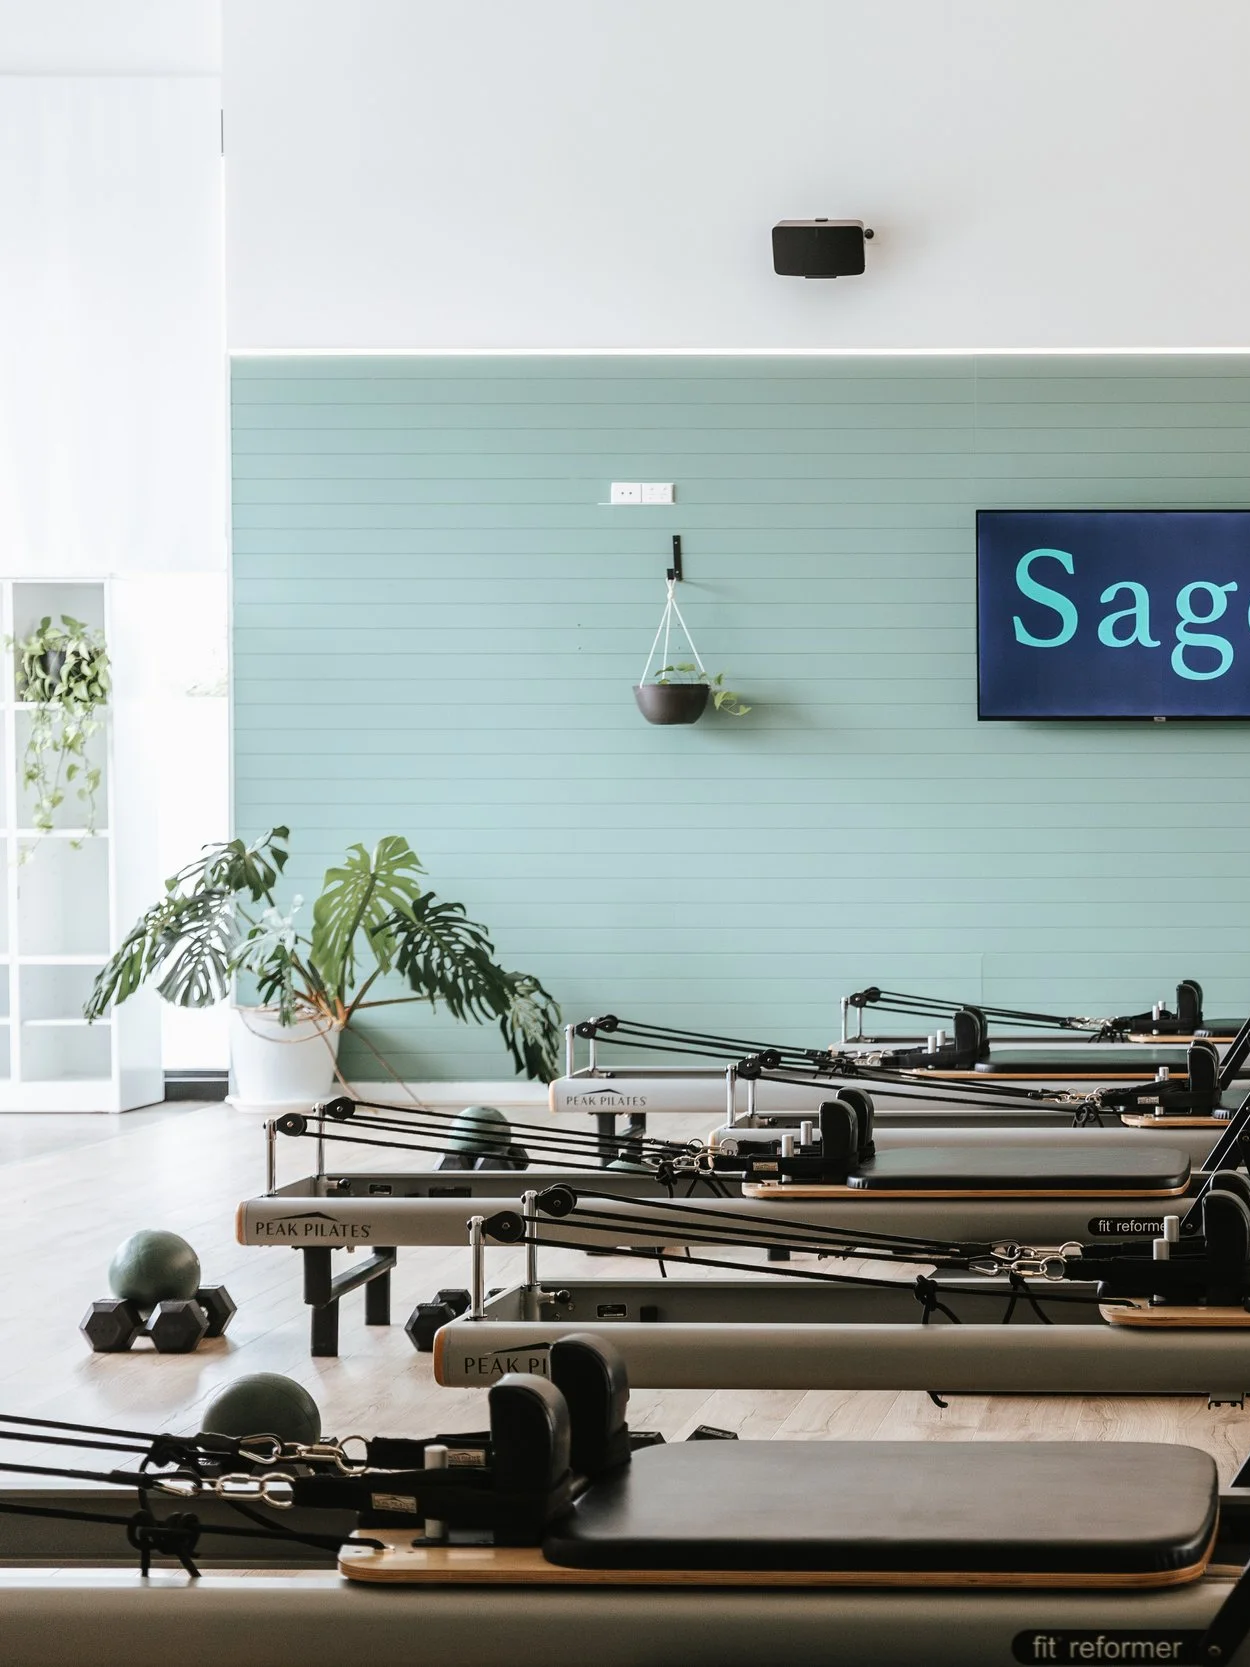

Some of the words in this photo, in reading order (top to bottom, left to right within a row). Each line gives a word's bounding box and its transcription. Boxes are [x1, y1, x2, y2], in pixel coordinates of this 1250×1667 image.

[566, 1096, 596, 1106] PEAK
[600, 1096, 647, 1107] PILATES
[255, 1221, 298, 1237] PEAK
[304, 1223, 371, 1239] PILATES
[1098, 1219, 1111, 1232] fit
[1116, 1219, 1165, 1232] reforme
[464, 1357, 519, 1375] PEAK
[1032, 1635, 1057, 1659] fit
[1069, 1635, 1183, 1659] reformer
